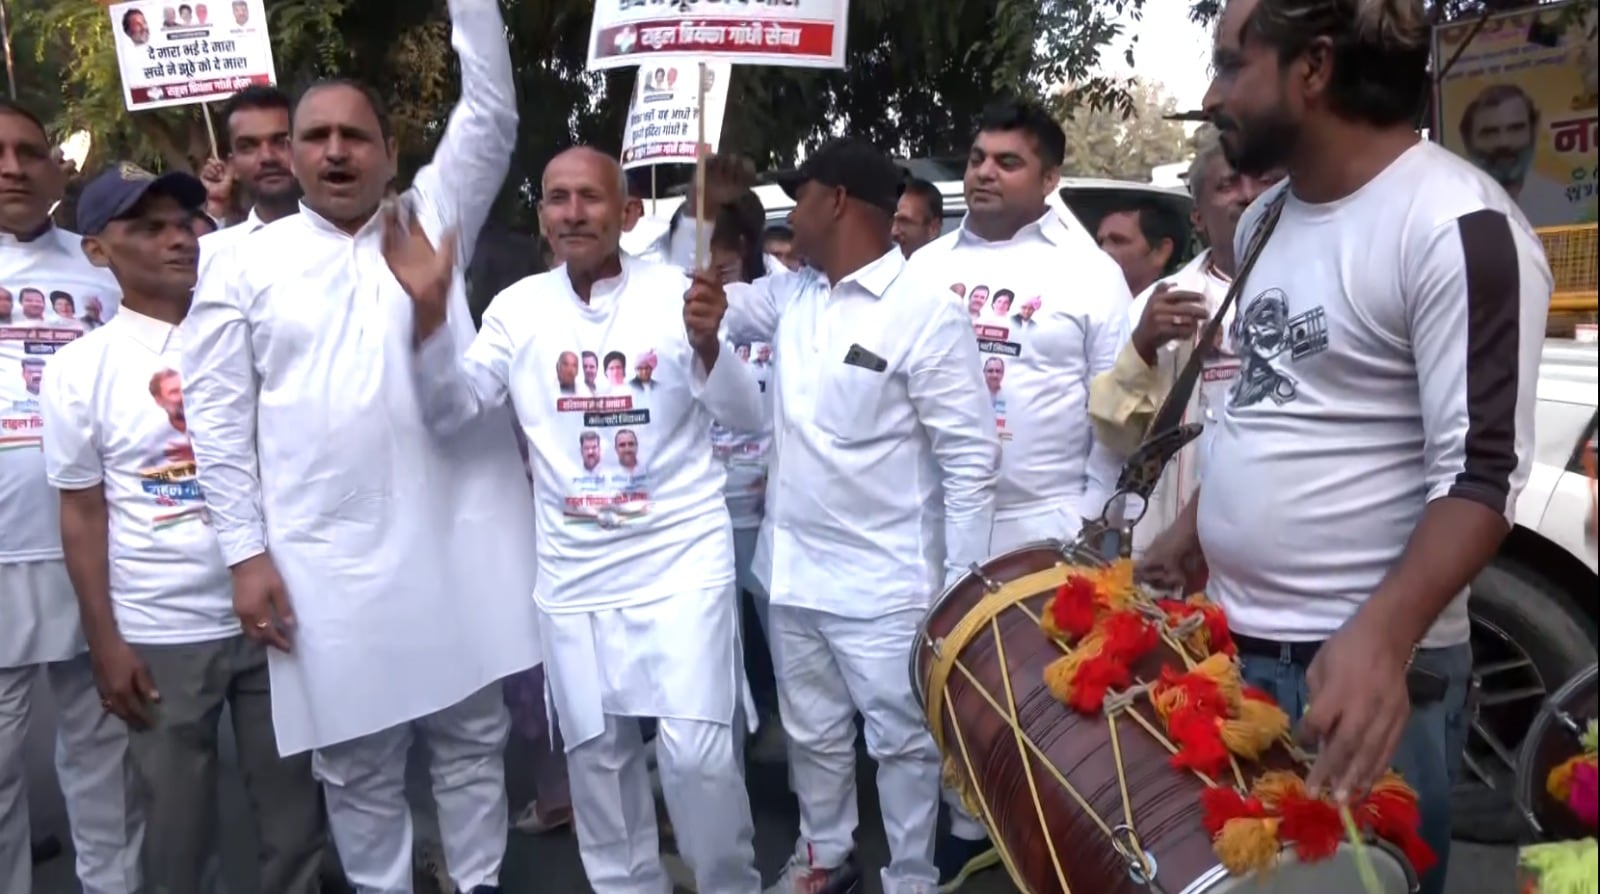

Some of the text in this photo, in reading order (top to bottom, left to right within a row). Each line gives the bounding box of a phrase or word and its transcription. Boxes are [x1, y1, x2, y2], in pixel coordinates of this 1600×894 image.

[640, 20, 802, 49] राहुल प्रियंका गांधी सेना
[147, 45, 156, 60] दे
[156, 45, 181, 58] मारा
[201, 39, 209, 54] दे
[210, 40, 236, 53] मारा
[166, 61, 177, 76] ने
[177, 58, 196, 77] झूठे
[196, 57, 212, 72] को
[212, 56, 221, 70] दे
[221, 57, 248, 70] मारा
